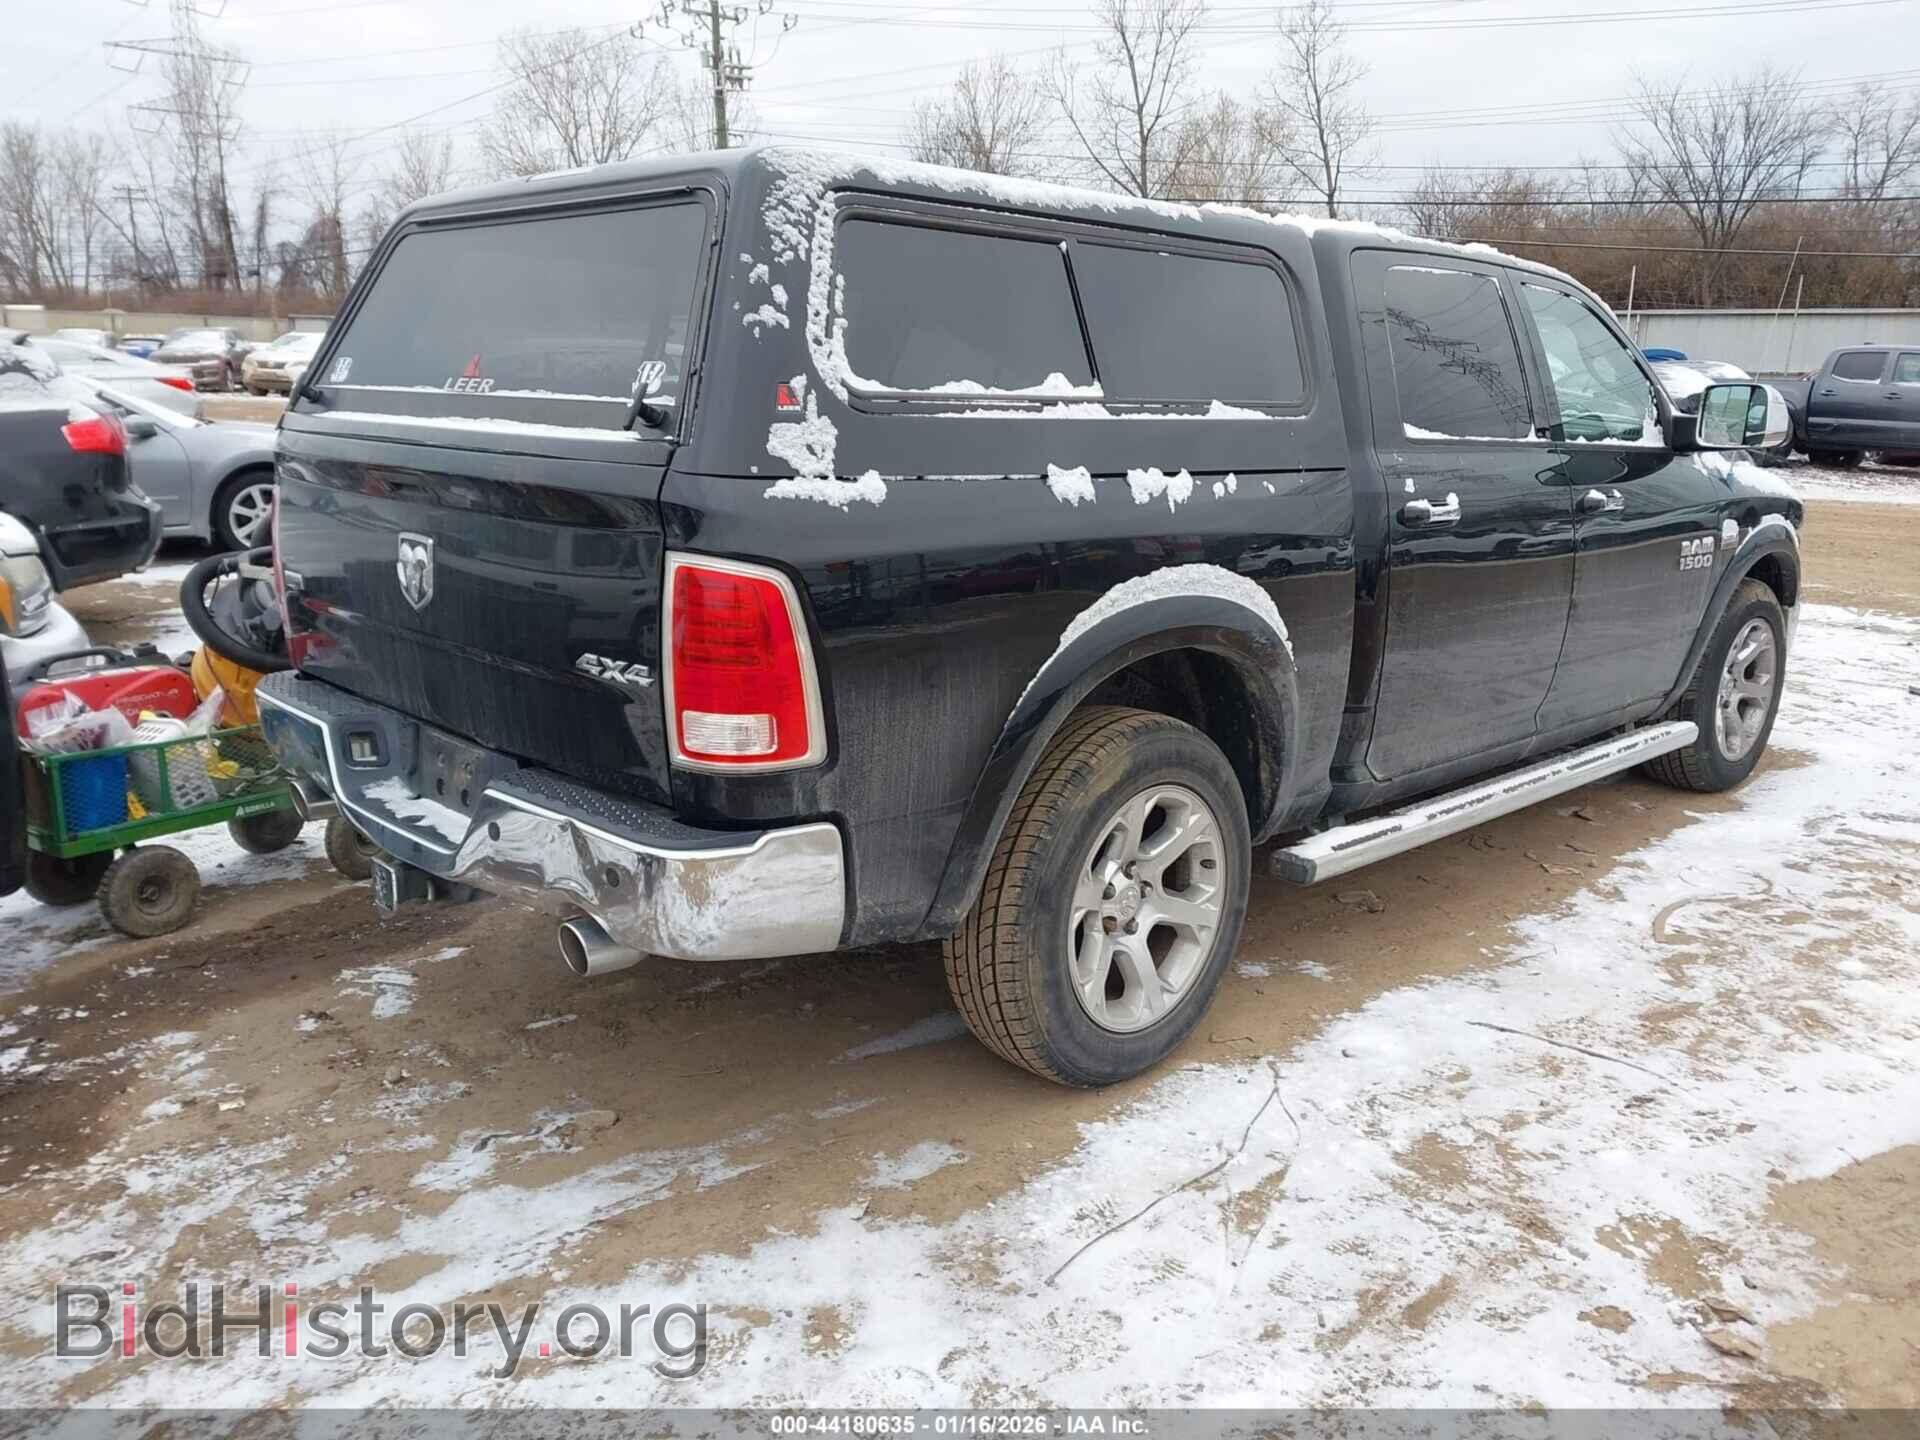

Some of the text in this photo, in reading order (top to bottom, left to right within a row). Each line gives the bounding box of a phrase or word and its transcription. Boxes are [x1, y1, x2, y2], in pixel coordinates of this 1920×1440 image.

[443, 377, 495, 393] LEER
[1681, 536, 1714, 556] RAM
[1679, 554, 1713, 571] 1500
